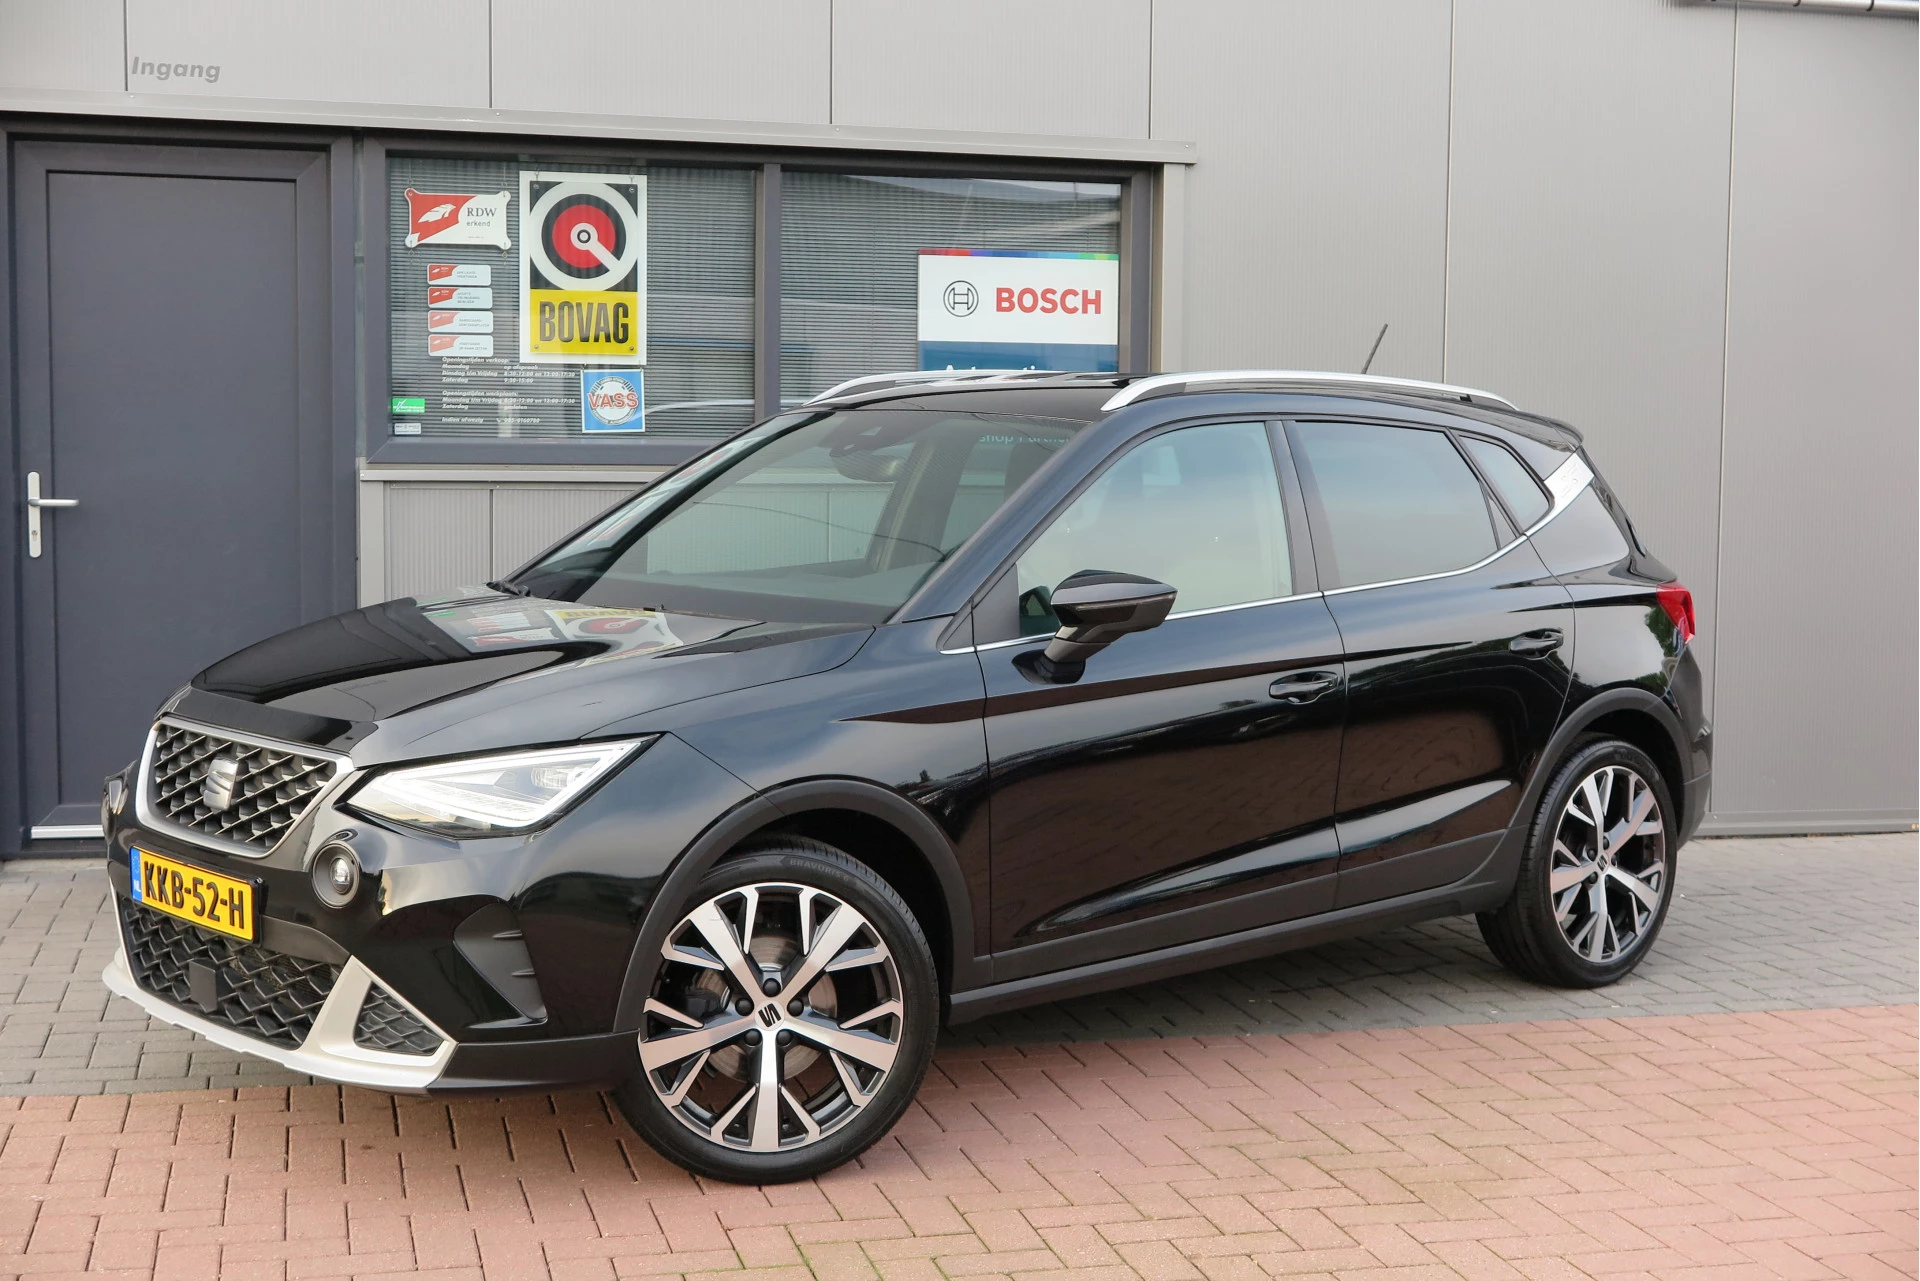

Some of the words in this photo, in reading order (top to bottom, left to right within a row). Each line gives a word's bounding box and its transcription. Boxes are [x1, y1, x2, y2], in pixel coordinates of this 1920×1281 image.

[131, 56, 221, 83] Ingang
[467, 207, 497, 217] RDW
[996, 287, 1102, 315] BOSCH
[539, 301, 629, 343] BOVAG
[588, 392, 638, 409] VASS
[144, 860, 245, 930] KKB-52-H
